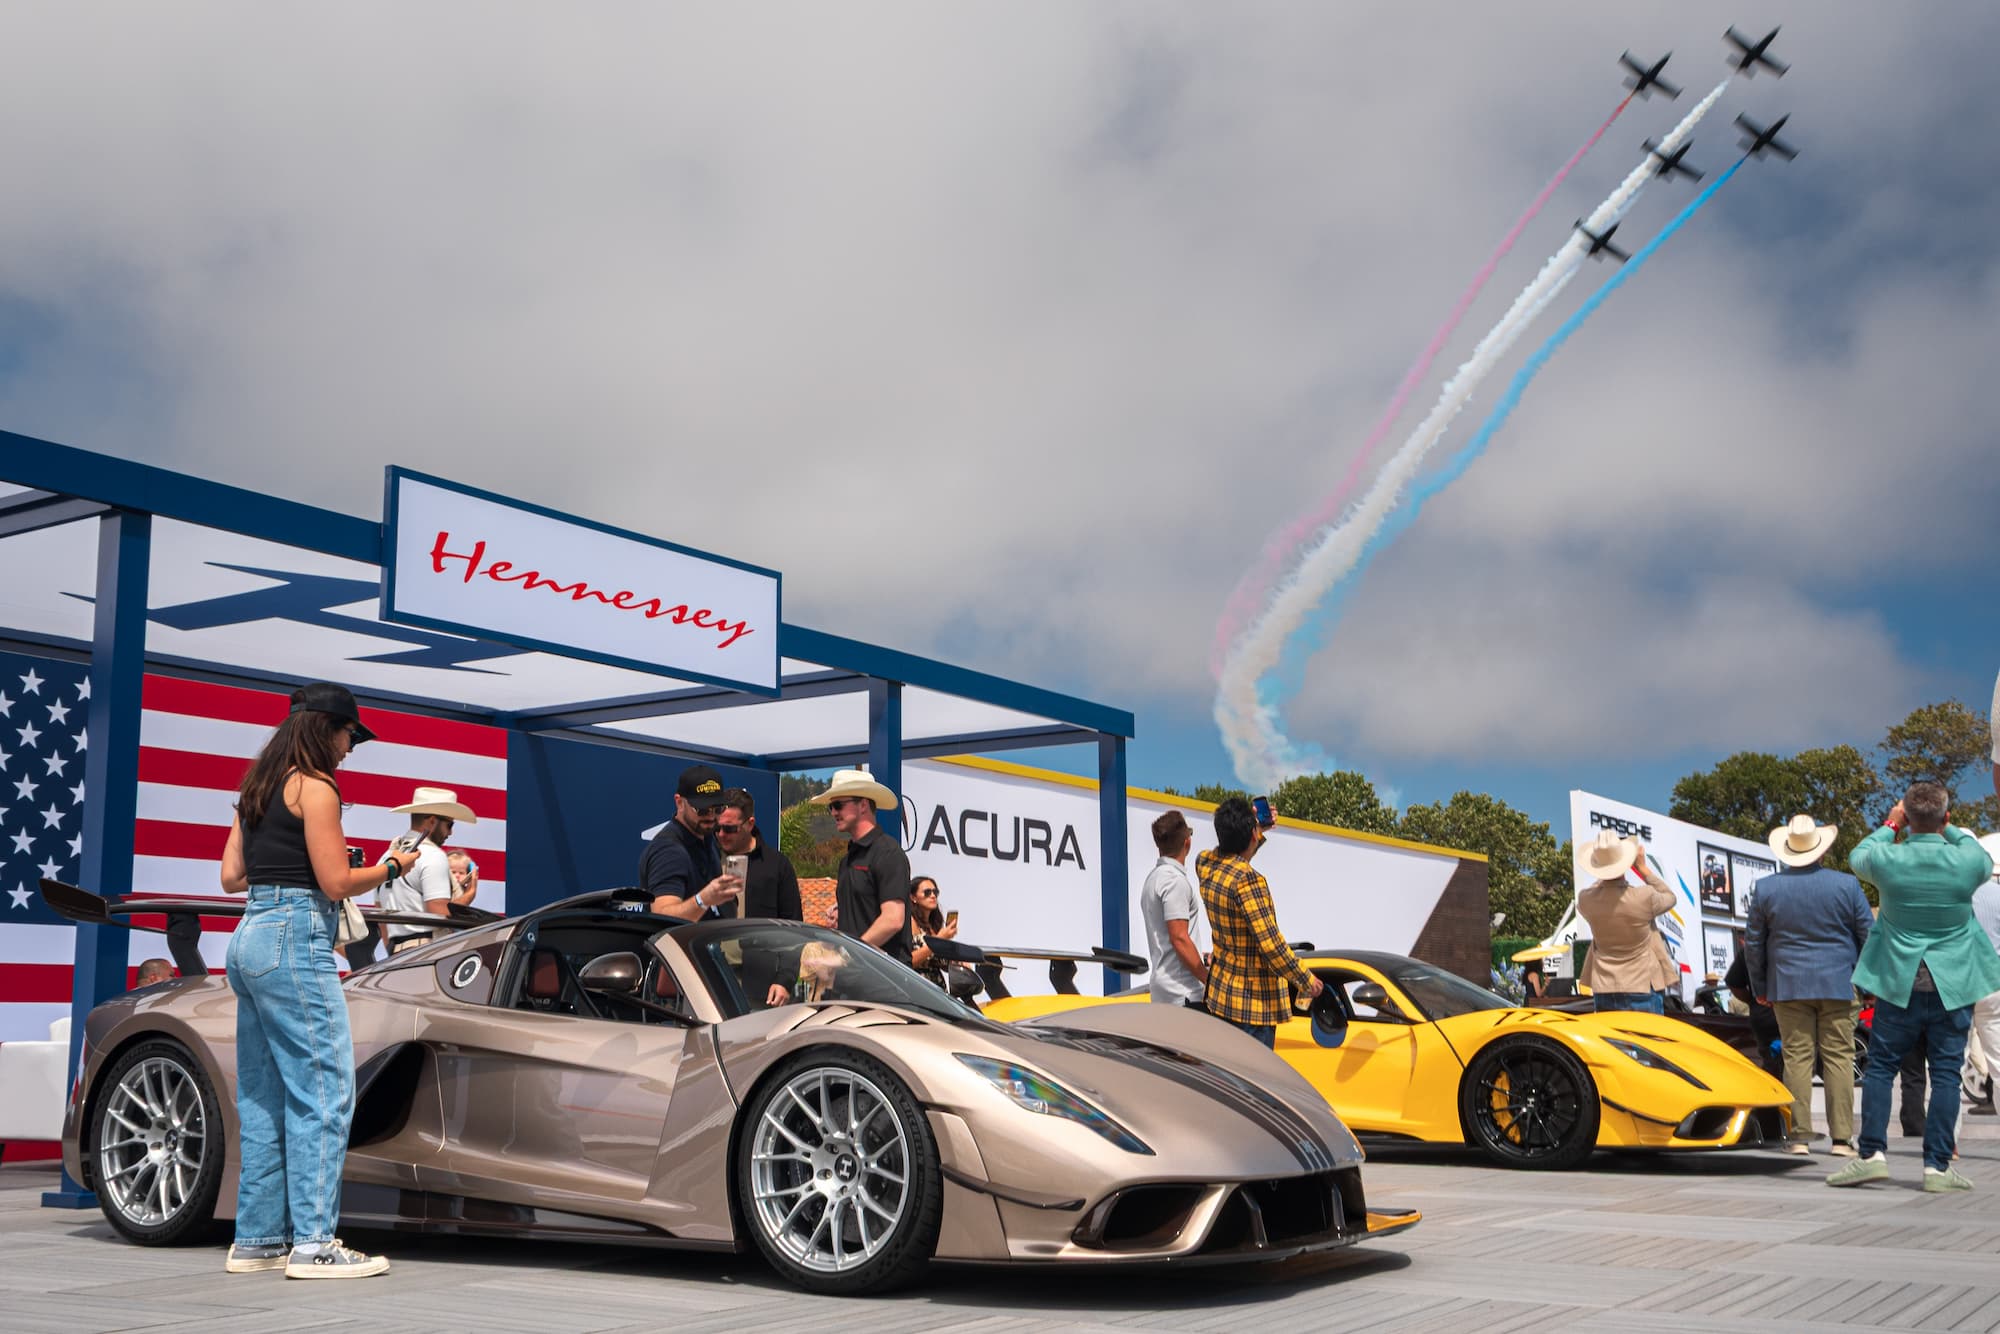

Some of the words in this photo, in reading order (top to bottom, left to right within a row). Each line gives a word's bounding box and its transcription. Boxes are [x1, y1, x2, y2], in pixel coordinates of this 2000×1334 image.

[430, 531, 755, 649] Hennessey
[921, 804, 1086, 870] ACURA
[1590, 810, 1652, 841] PORSCHE
